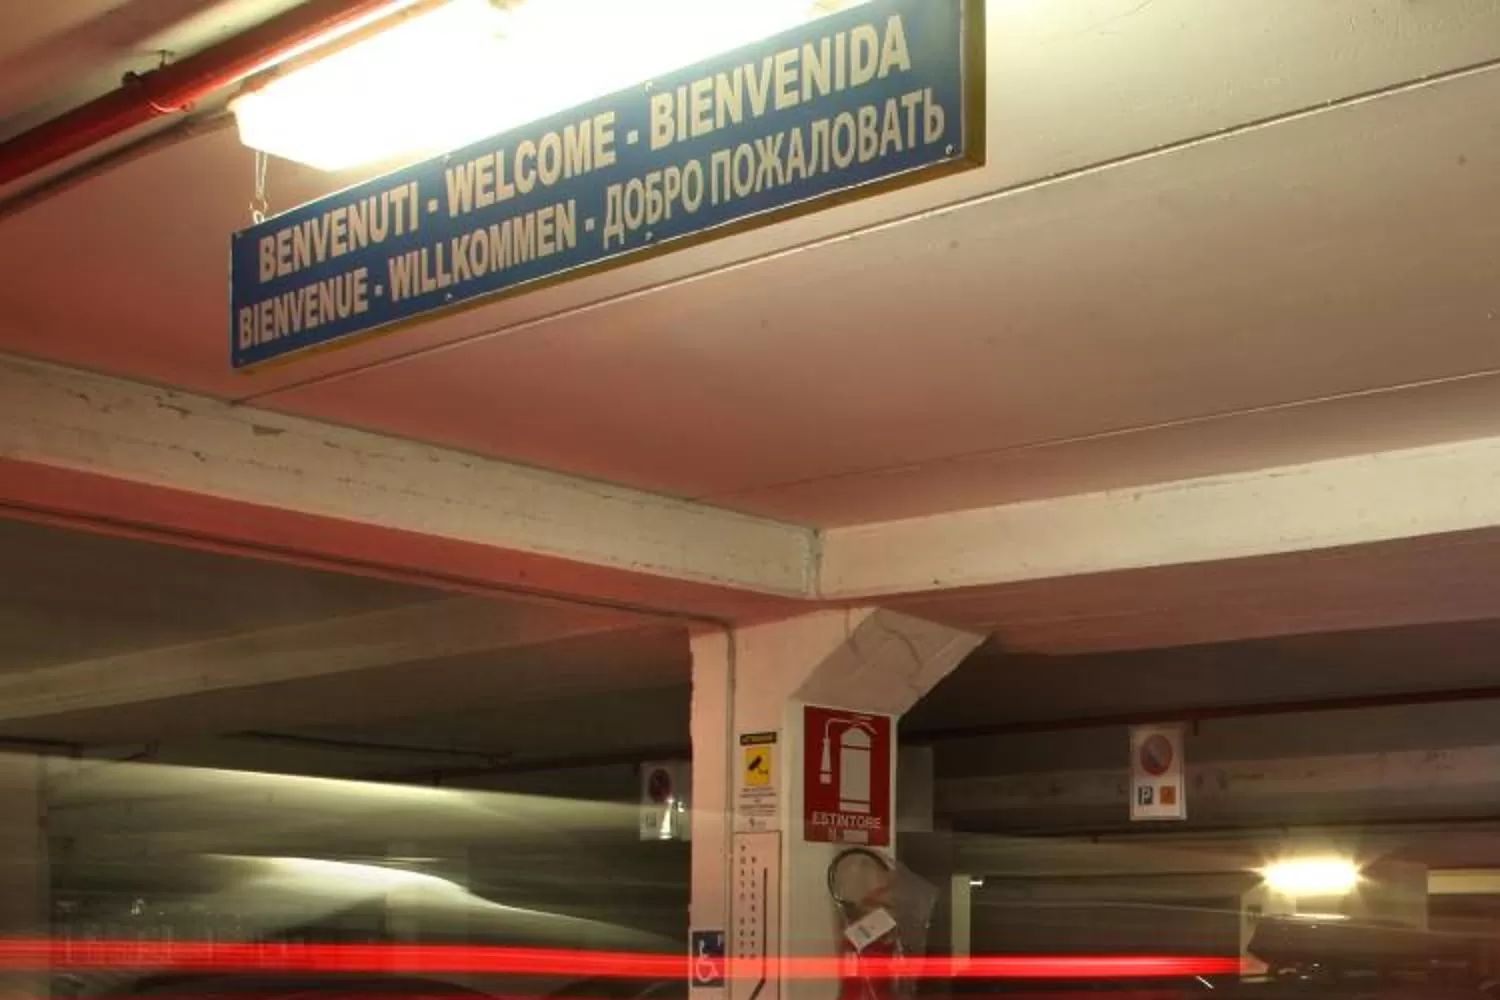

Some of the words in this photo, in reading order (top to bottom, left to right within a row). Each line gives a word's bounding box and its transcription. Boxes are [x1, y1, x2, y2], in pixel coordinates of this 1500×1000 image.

[258, 181, 419, 283] BENVENUTI
[445, 110, 617, 217] WELCOME
[651, 13, 912, 150] BIENVENIDA
[603, 158, 705, 249] ДОБРО
[711, 87, 946, 207] ПОЖАЛОВАТЬ
[238, 266, 369, 350] BIENVENUE
[388, 198, 577, 303] WILLKOMMEN
[812, 810, 881, 829] ESTINTORE
